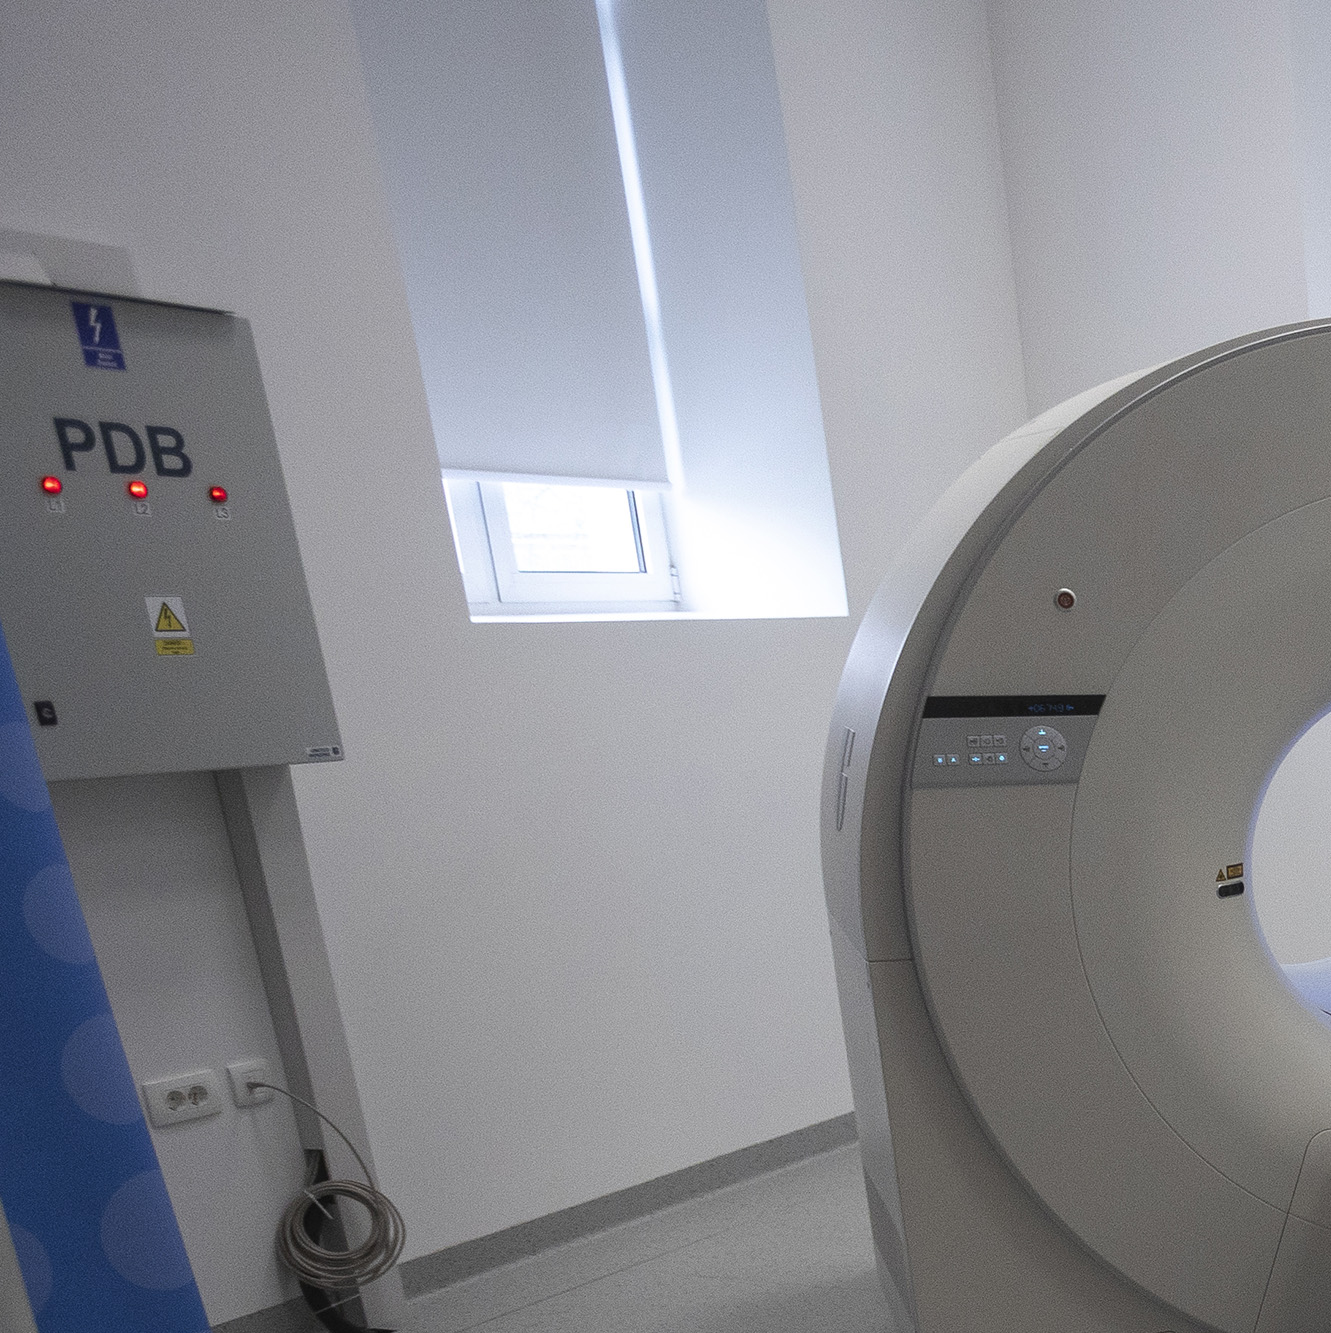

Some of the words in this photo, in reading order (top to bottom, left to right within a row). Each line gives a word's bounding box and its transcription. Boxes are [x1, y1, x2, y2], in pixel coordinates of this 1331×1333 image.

[53, 417, 193, 478] PDB
[49, 500, 63, 511] L1
[134, 504, 150, 515] L2
[216, 508, 229, 519] L3
